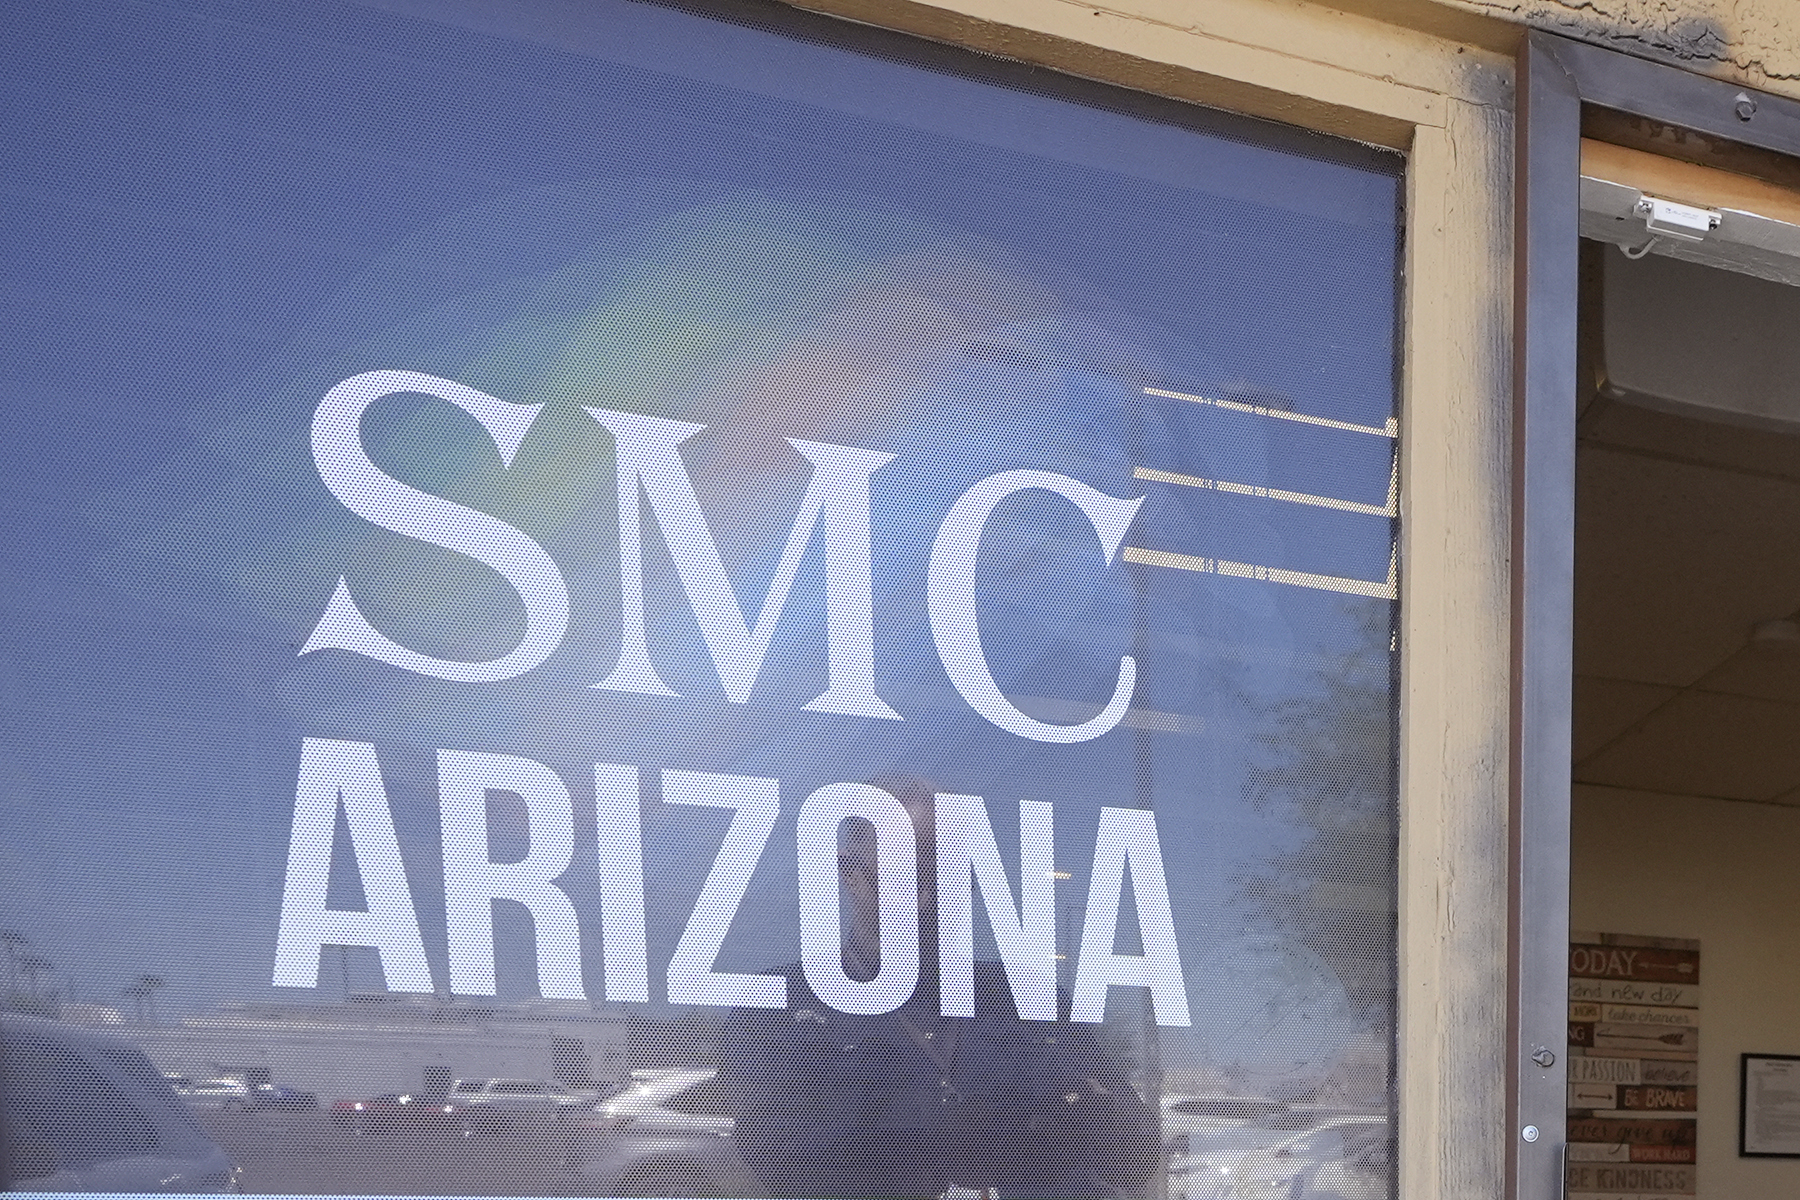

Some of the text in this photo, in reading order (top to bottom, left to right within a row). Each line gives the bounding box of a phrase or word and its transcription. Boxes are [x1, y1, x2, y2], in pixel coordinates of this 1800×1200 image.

[295, 368, 1145, 745] SMC
[271, 737, 1192, 1028] ARIZONA
[1611, 984, 1644, 1000] new
[1650, 986, 1683, 1004] day
[1582, 1059, 1636, 1082] PASSION
[1624, 1088, 1685, 1109] BE BRAVE
[1597, 1168, 1686, 1191] KINDNESS
